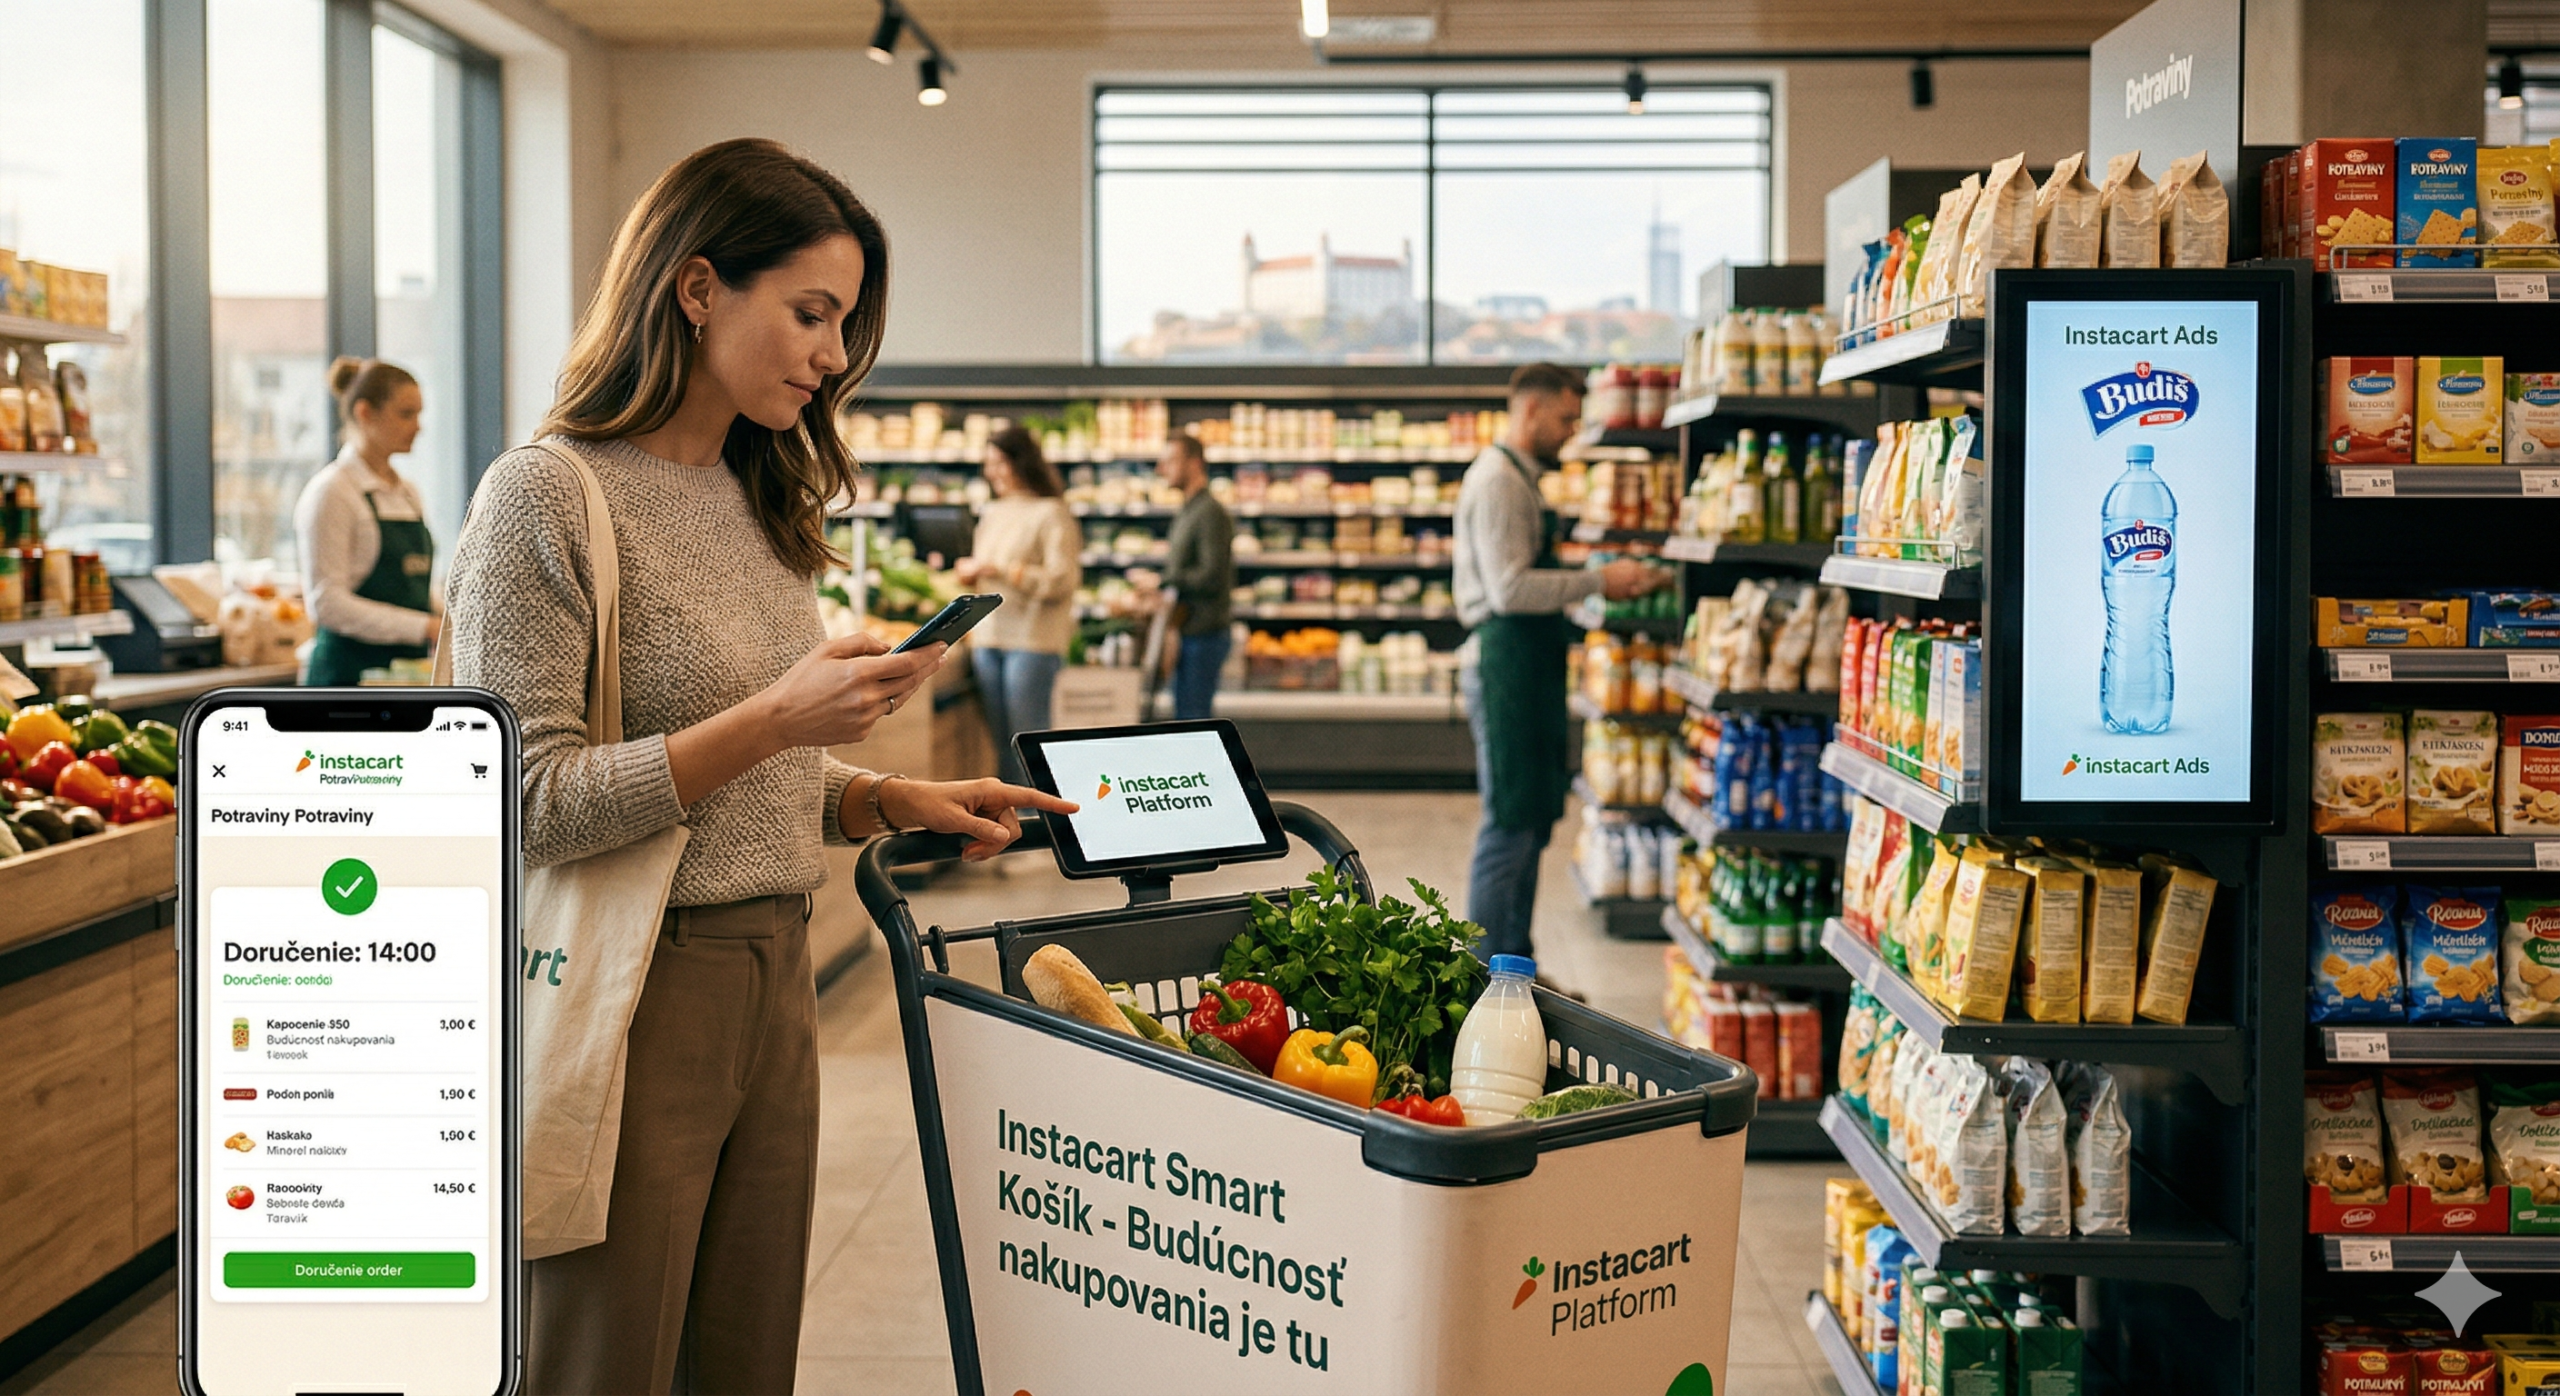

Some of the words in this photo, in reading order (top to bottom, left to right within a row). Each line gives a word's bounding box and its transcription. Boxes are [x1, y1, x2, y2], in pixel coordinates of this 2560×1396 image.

[2125, 53, 2193, 119] Potraviny
[2065, 325, 2168, 345] Instacart
[2174, 325, 2219, 345] Ads
[2095, 374, 2189, 420] Budiš
[2109, 529, 2167, 557] Budiš
[222, 721, 249, 732] 9:41
[319, 754, 404, 770] instacart
[2086, 757, 2170, 774] instacart
[2174, 757, 2210, 774] Ads
[1118, 772, 1210, 793] instacart
[1125, 793, 1213, 814] Platform
[210, 809, 290, 826] Potraviny
[294, 809, 374, 826] Potraviny
[223, 940, 361, 963] Doručenie:
[367, 942, 437, 963] 14:00
[467, 1019, 476, 1030] €
[467, 1088, 476, 1100] €
[467, 1130, 476, 1141] €
[998, 1109, 1156, 1190] Instacart
[1165, 1152, 1286, 1224] Smart
[433, 1183, 465, 1195] 14,50
[467, 1183, 476, 1194] €
[999, 1170, 1093, 1236] Košík
[1128, 1205, 1347, 1308] Budúcnosť
[295, 1264, 363, 1277] Doručenie
[366, 1264, 403, 1277] order
[1553, 1233, 1692, 1293] Instacart
[999, 1240, 1230, 1342] nakupovania
[1239, 1301, 1276, 1357] je
[1286, 1320, 1328, 1372] tu
[1551, 1283, 1676, 1337] Platform
